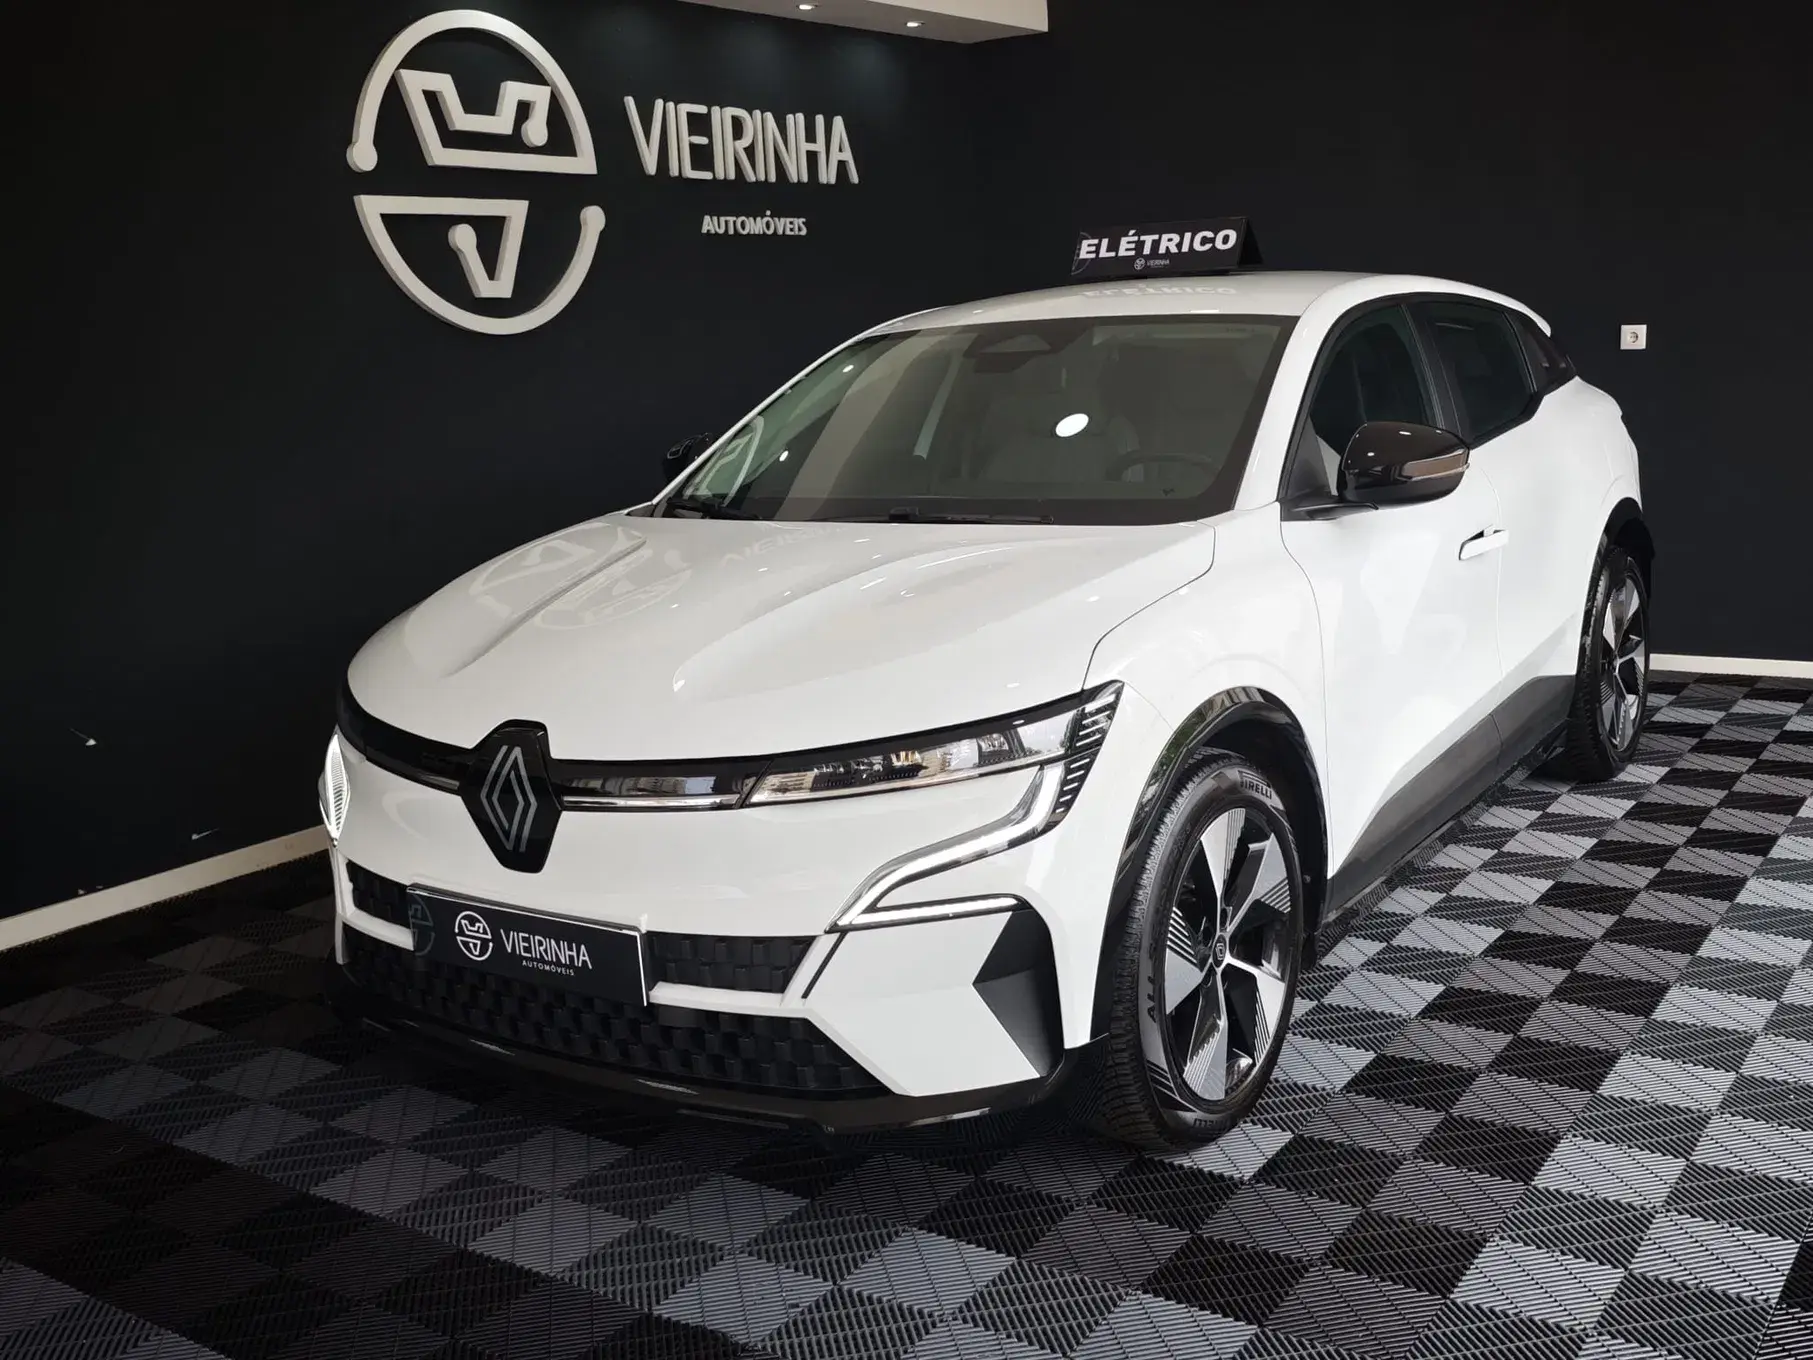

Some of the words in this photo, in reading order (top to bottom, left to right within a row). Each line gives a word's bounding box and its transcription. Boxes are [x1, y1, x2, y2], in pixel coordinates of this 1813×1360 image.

[624, 96, 859, 184] VIEIRINHA
[701, 210, 807, 236] AUTOMÓVEIS
[1079, 229, 1238, 259] ELÉTRICO
[500, 928, 592, 970] VIEIRINHA
[522, 959, 575, 976] AUTOMÓVEIS
